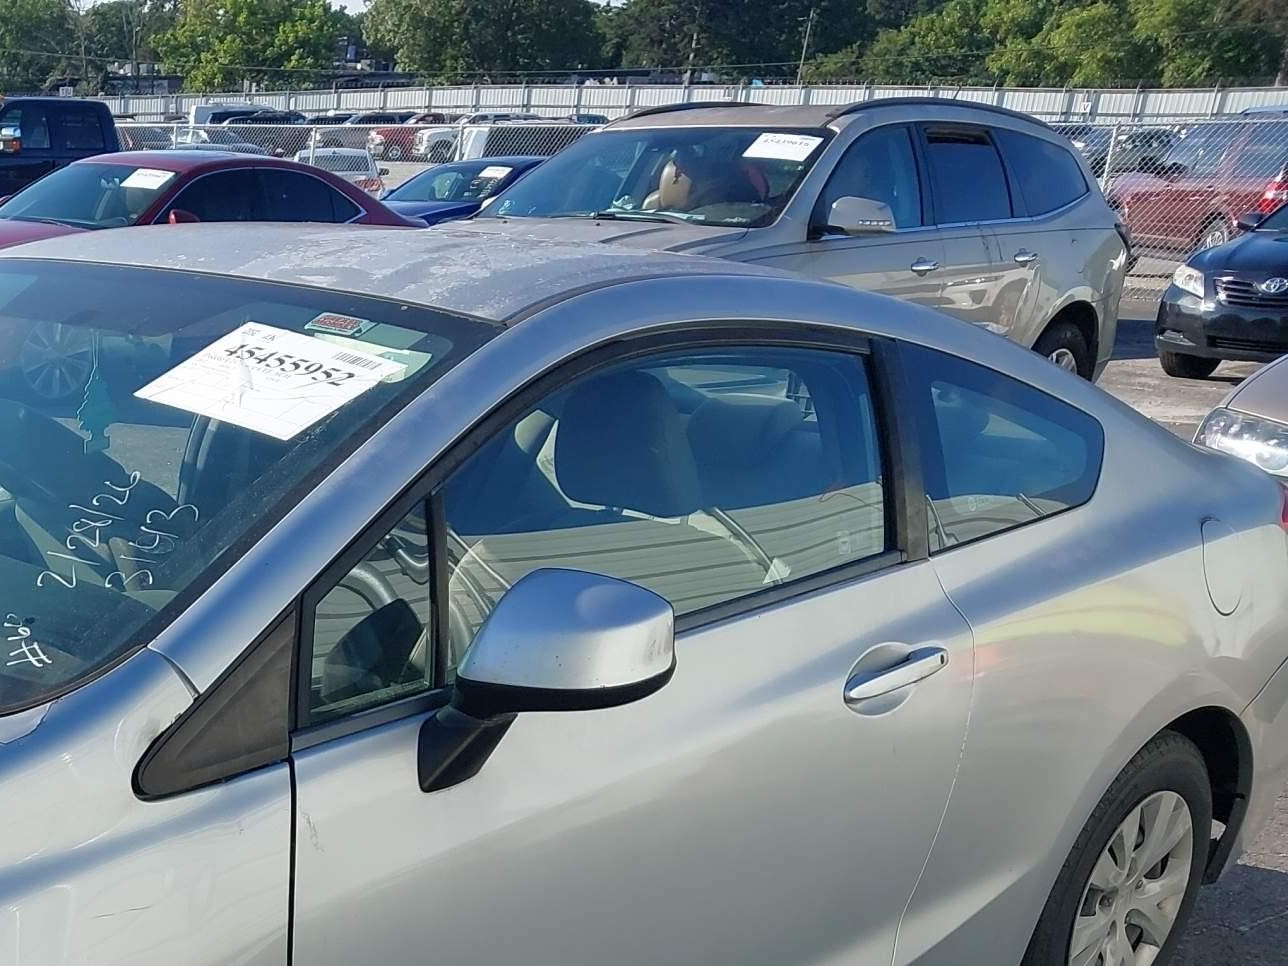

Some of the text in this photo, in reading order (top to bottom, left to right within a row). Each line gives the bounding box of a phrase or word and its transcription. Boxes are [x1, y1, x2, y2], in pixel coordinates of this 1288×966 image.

[224, 344, 356, 386] 45455952
[37, 471, 141, 588] 2/28/26
[104, 504, 199, 588] 3143
